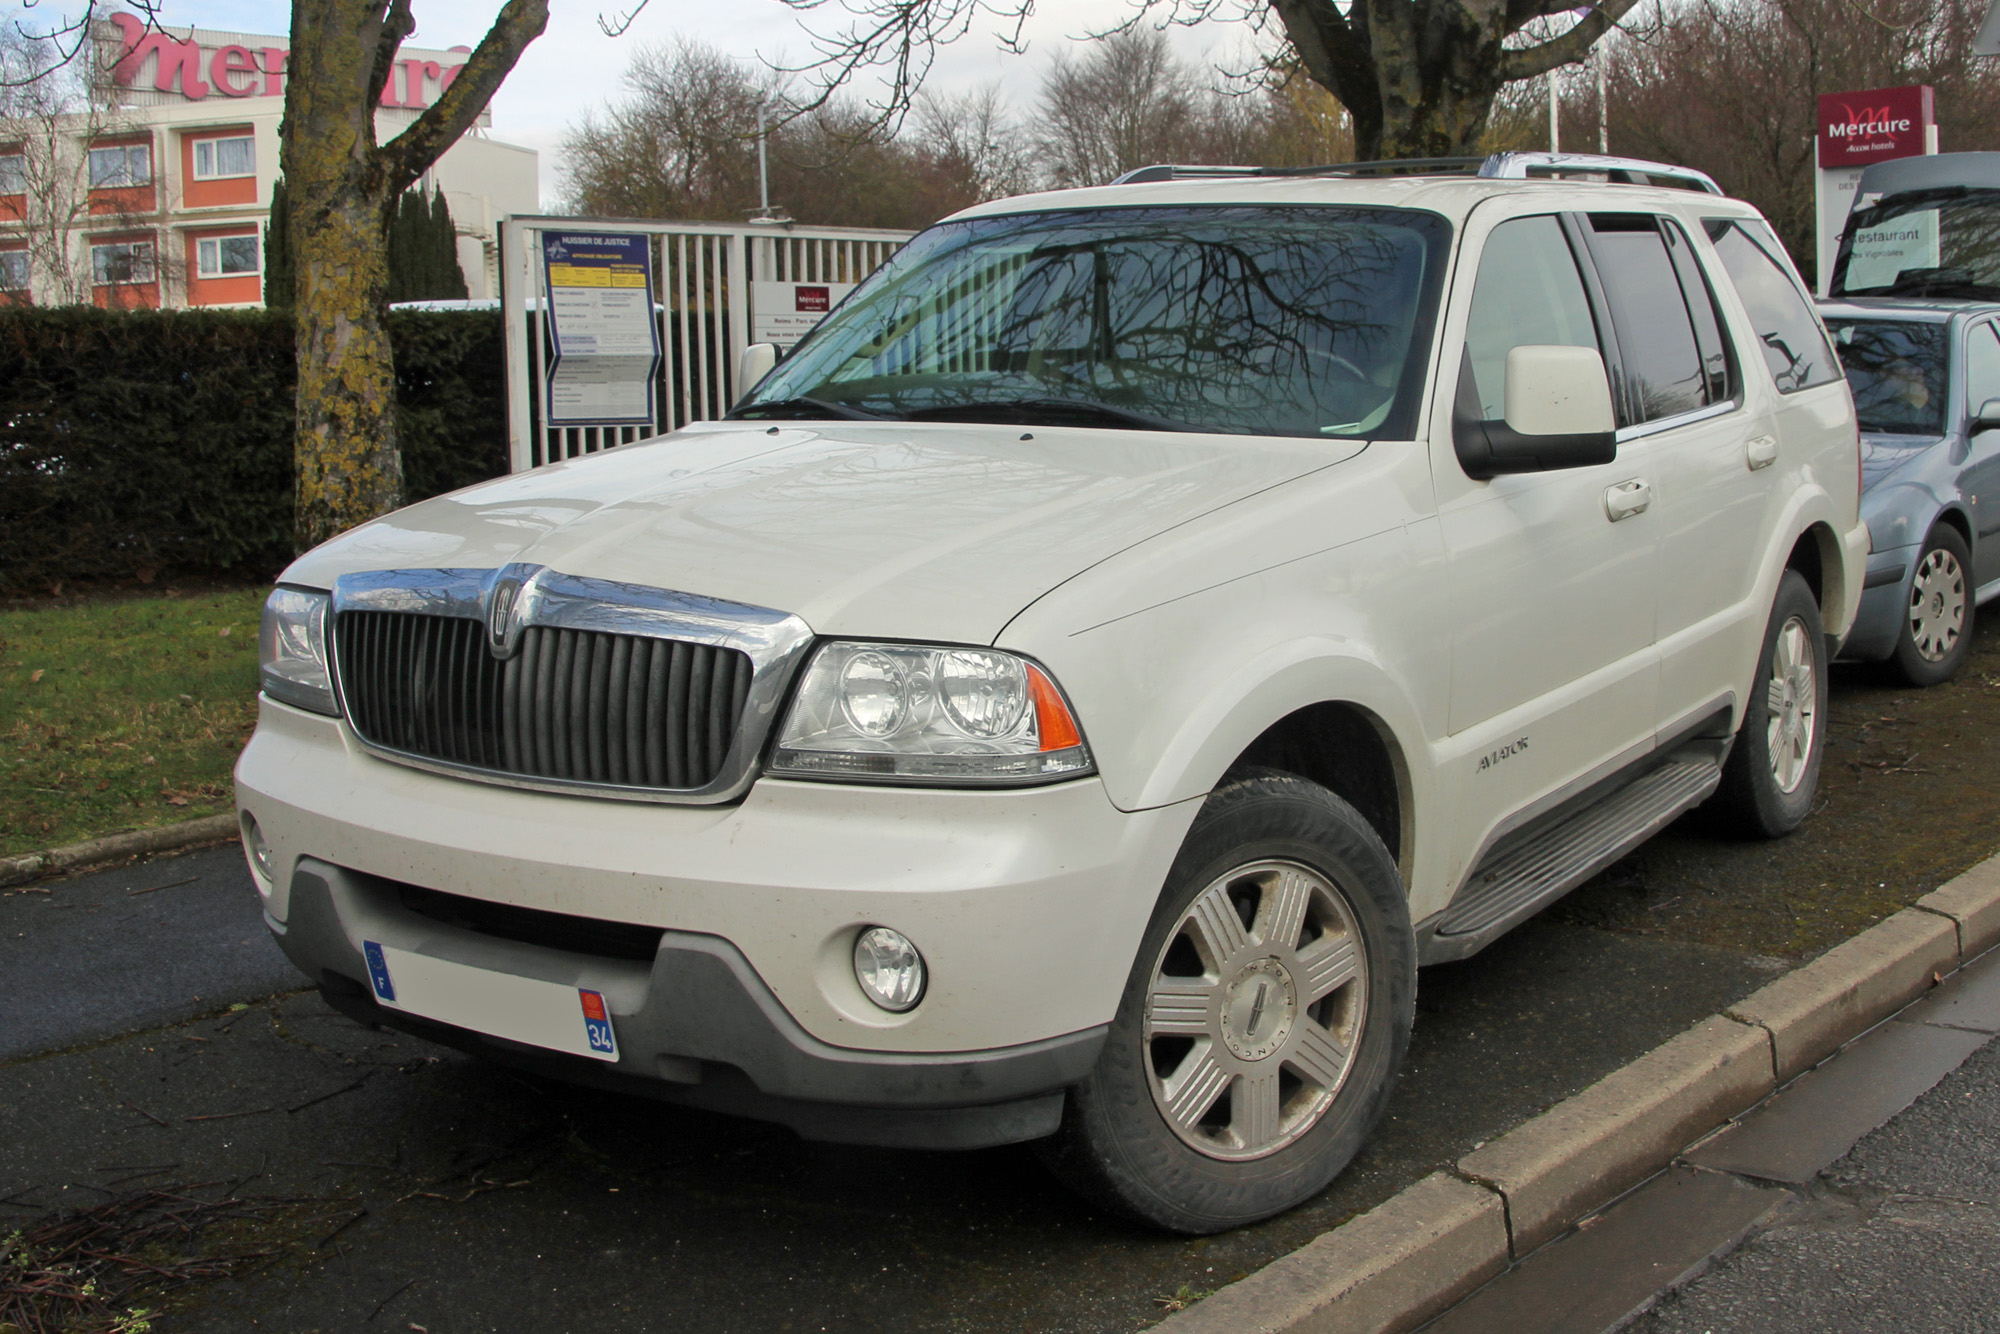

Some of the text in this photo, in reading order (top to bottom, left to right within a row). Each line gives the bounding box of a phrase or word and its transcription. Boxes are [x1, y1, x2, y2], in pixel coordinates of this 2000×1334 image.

[1828, 118, 1910, 138] Mercure
[1871, 141, 1895, 151] hotels
[562, 236, 631, 247] HUISSIER DE JUSTICE
[1853, 229, 1919, 243] estaurant
[1864, 249, 1904, 259] Vignobles
[798, 295, 827, 304] Mercure
[1475, 736, 1528, 774] AVIATOR
[377, 976, 385, 990] F
[588, 1023, 612, 1050] 34
